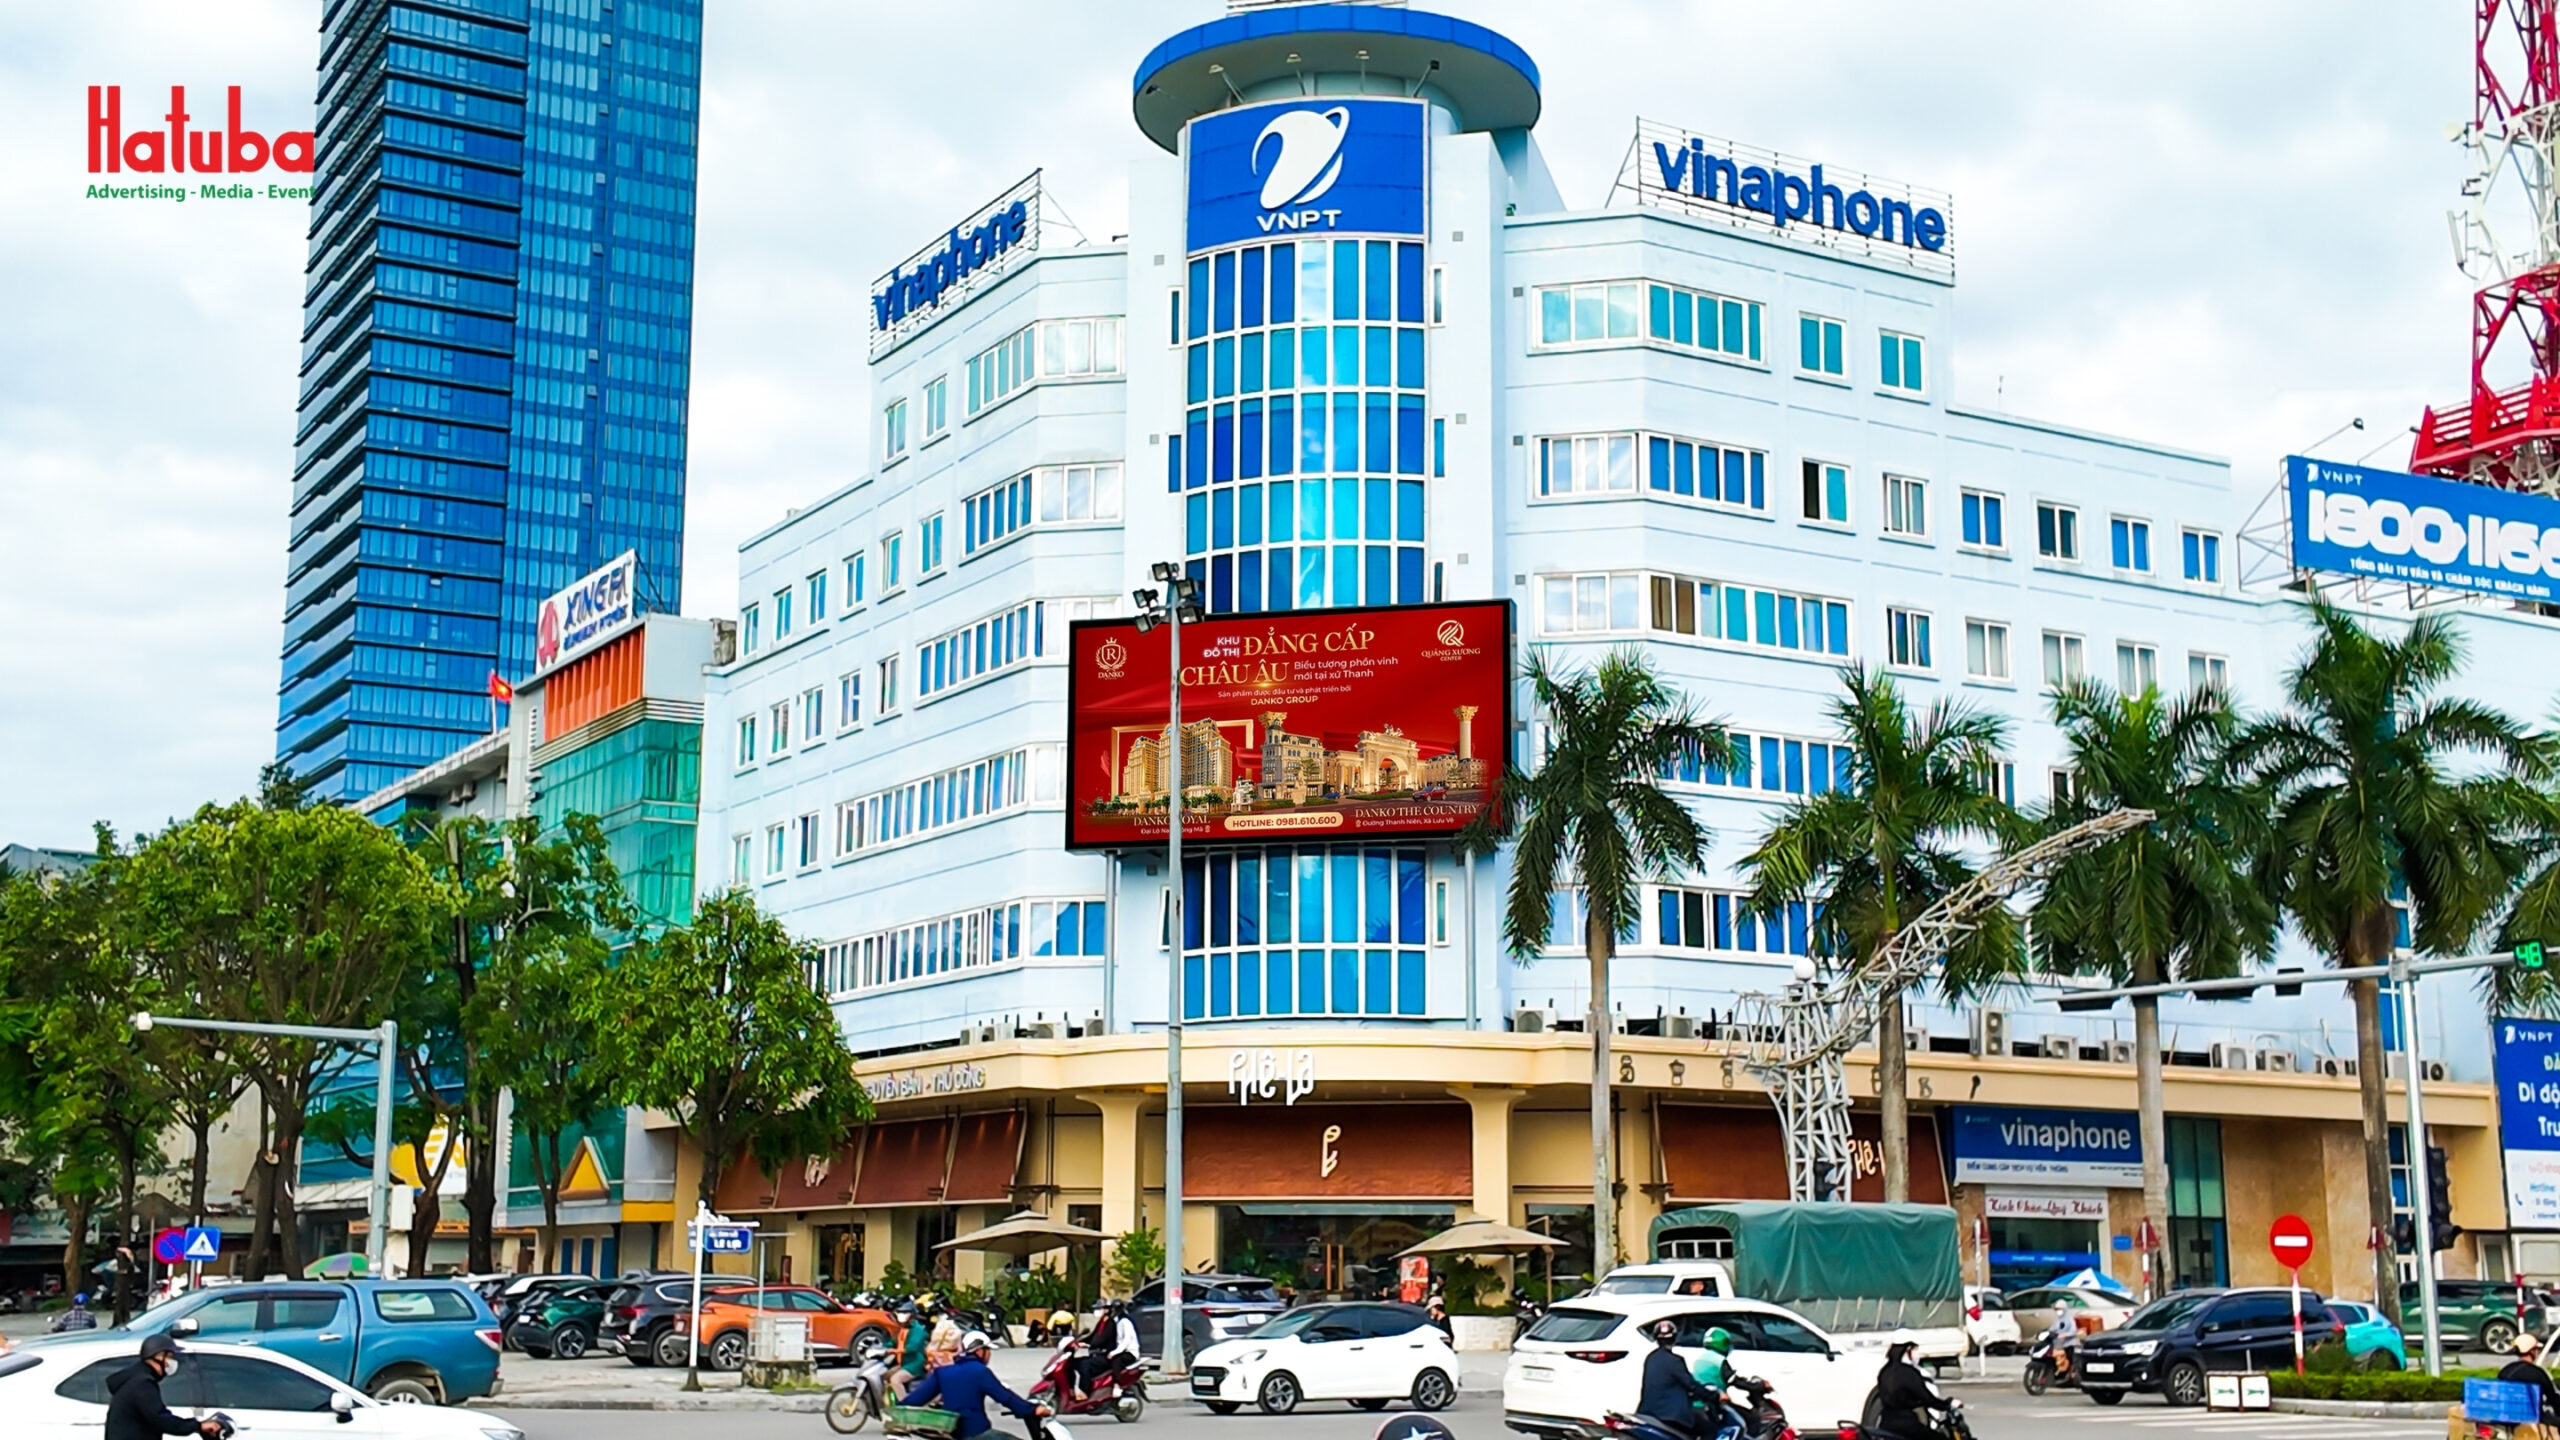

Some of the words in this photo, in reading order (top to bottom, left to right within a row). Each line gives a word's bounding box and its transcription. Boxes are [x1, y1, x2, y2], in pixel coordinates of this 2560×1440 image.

[1653, 138, 1946, 252] vinaphone
[1256, 209, 1342, 232] VNPT
[874, 201, 1027, 331] vinaphone
[2322, 469, 2363, 486] VNPT
[1217, 636, 1240, 646] KHU
[1243, 626, 1319, 657] ĐẲNG
[1324, 623, 1375, 652] CẤP
[1203, 647, 1221, 658] ĐÔ
[1222, 648, 1240, 659] THỊ
[1294, 660, 1315, 670] Biểu
[1318, 659, 1347, 670] tượng
[1349, 657, 1375, 668] phồn
[1377, 656, 1399, 665] vinh
[1180, 660, 1250, 687] CHÂU
[1253, 659, 1290, 684] ÂU
[1294, 671, 1313, 681] mới
[1314, 670, 1327, 681] tại
[1329, 670, 1342, 679] xứ
[1343, 668, 1374, 679] Thanh
[1251, 697, 1284, 706] DANKO
[1285, 695, 1319, 704] GROUP
[1355, 807, 1395, 818] DANKO
[1396, 806, 1422, 816] THE
[1423, 805, 1479, 816] COUNTRY
[1181, 815, 1211, 824] OYAL
[1232, 818, 1274, 828] HOTLINE:
[1275, 815, 1337, 827] 0981.610.600
[2516, 942, 2543, 968] 48
[2518, 1030, 2552, 1043] VNPT
[2001, 1116, 2132, 1152] vinaphone
